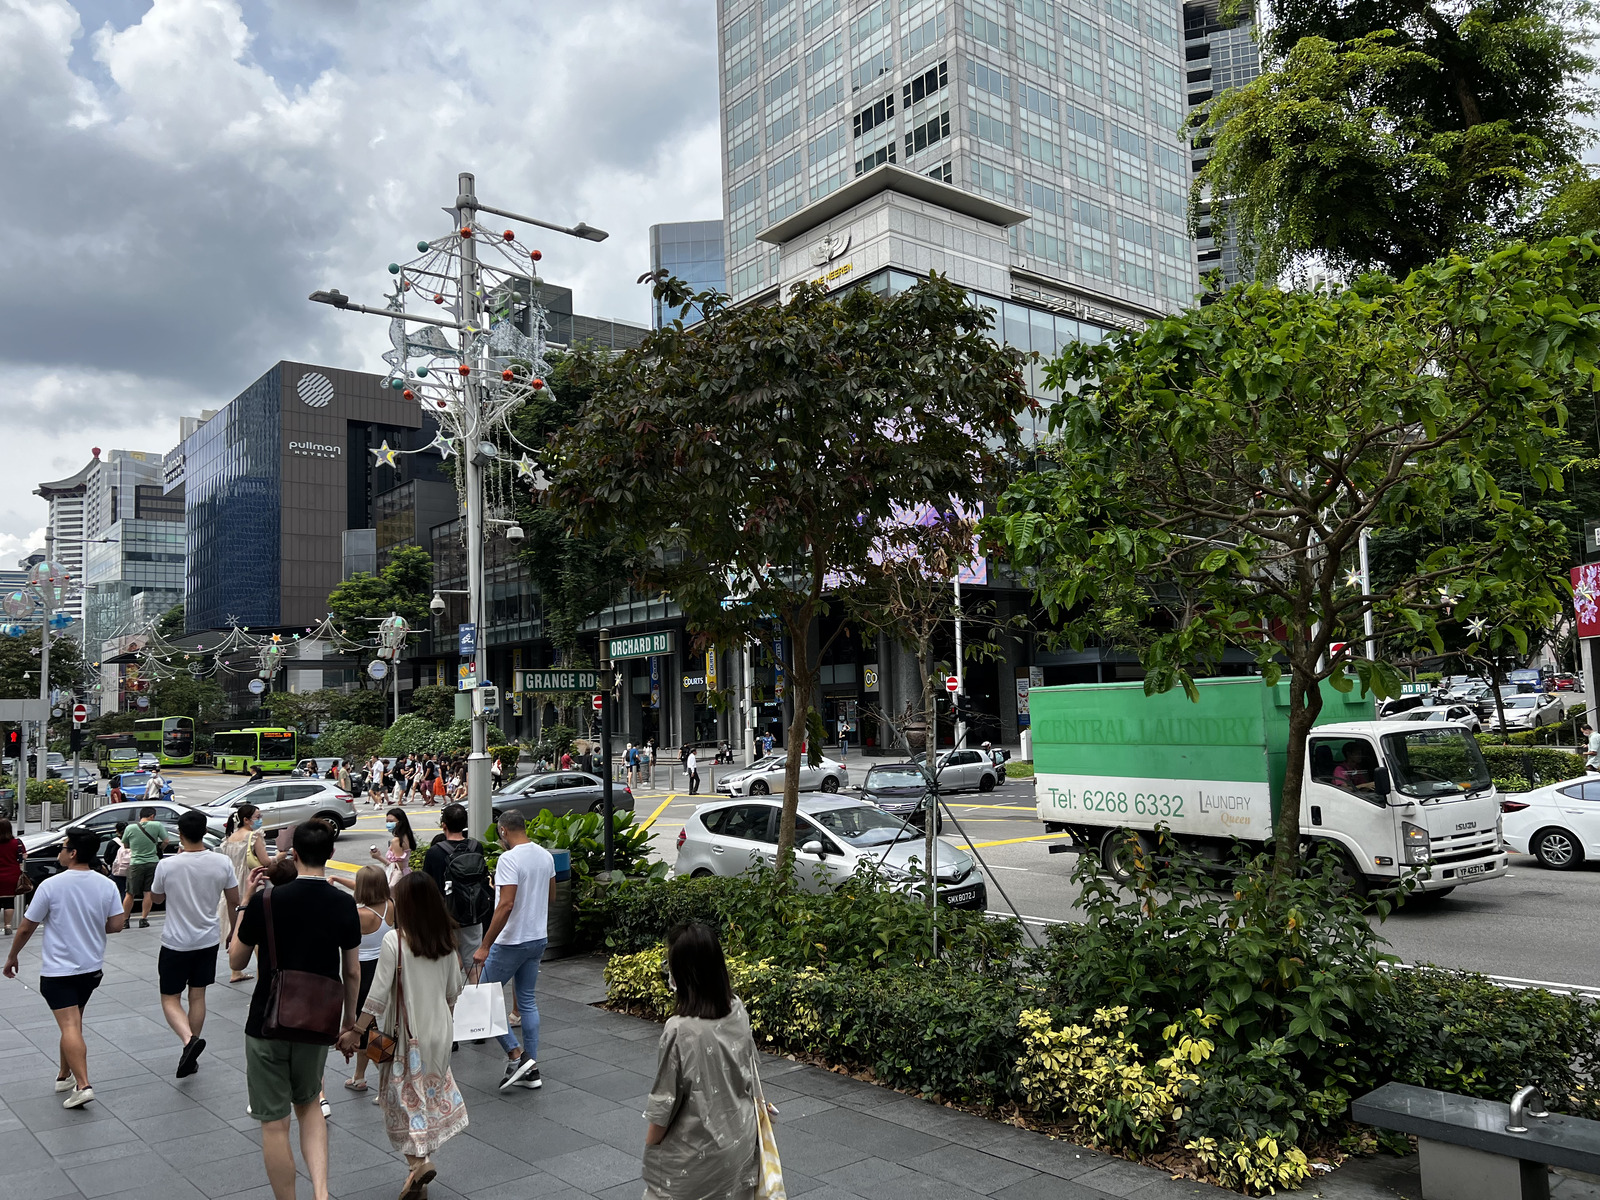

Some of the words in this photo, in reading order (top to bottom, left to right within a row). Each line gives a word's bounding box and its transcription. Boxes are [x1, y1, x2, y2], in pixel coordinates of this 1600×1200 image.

[826, 262, 853, 282] HEEREN
[289, 441, 341, 454] pullman
[294, 450, 335, 458] HOTELS
[611, 637, 651, 656] ORCHARD
[653, 634, 666, 651] RD
[525, 673, 575, 689] GRANGE
[579, 673, 595, 688] RD
[683, 676, 704, 688] COURTS
[1415, 684, 1427, 693] RD
[1038, 717, 1132, 743] CENTRAL
[1140, 717, 1255, 744] LAUNDRY
[1048, 787, 1077, 810] Tel:
[1083, 790, 1128, 813] 6268
[1134, 793, 1185, 818] 6332
[1199, 791, 1251, 814] LAUNDRY
[1220, 812, 1251, 826] Queen
[1455, 821, 1477, 831] ISUZU
